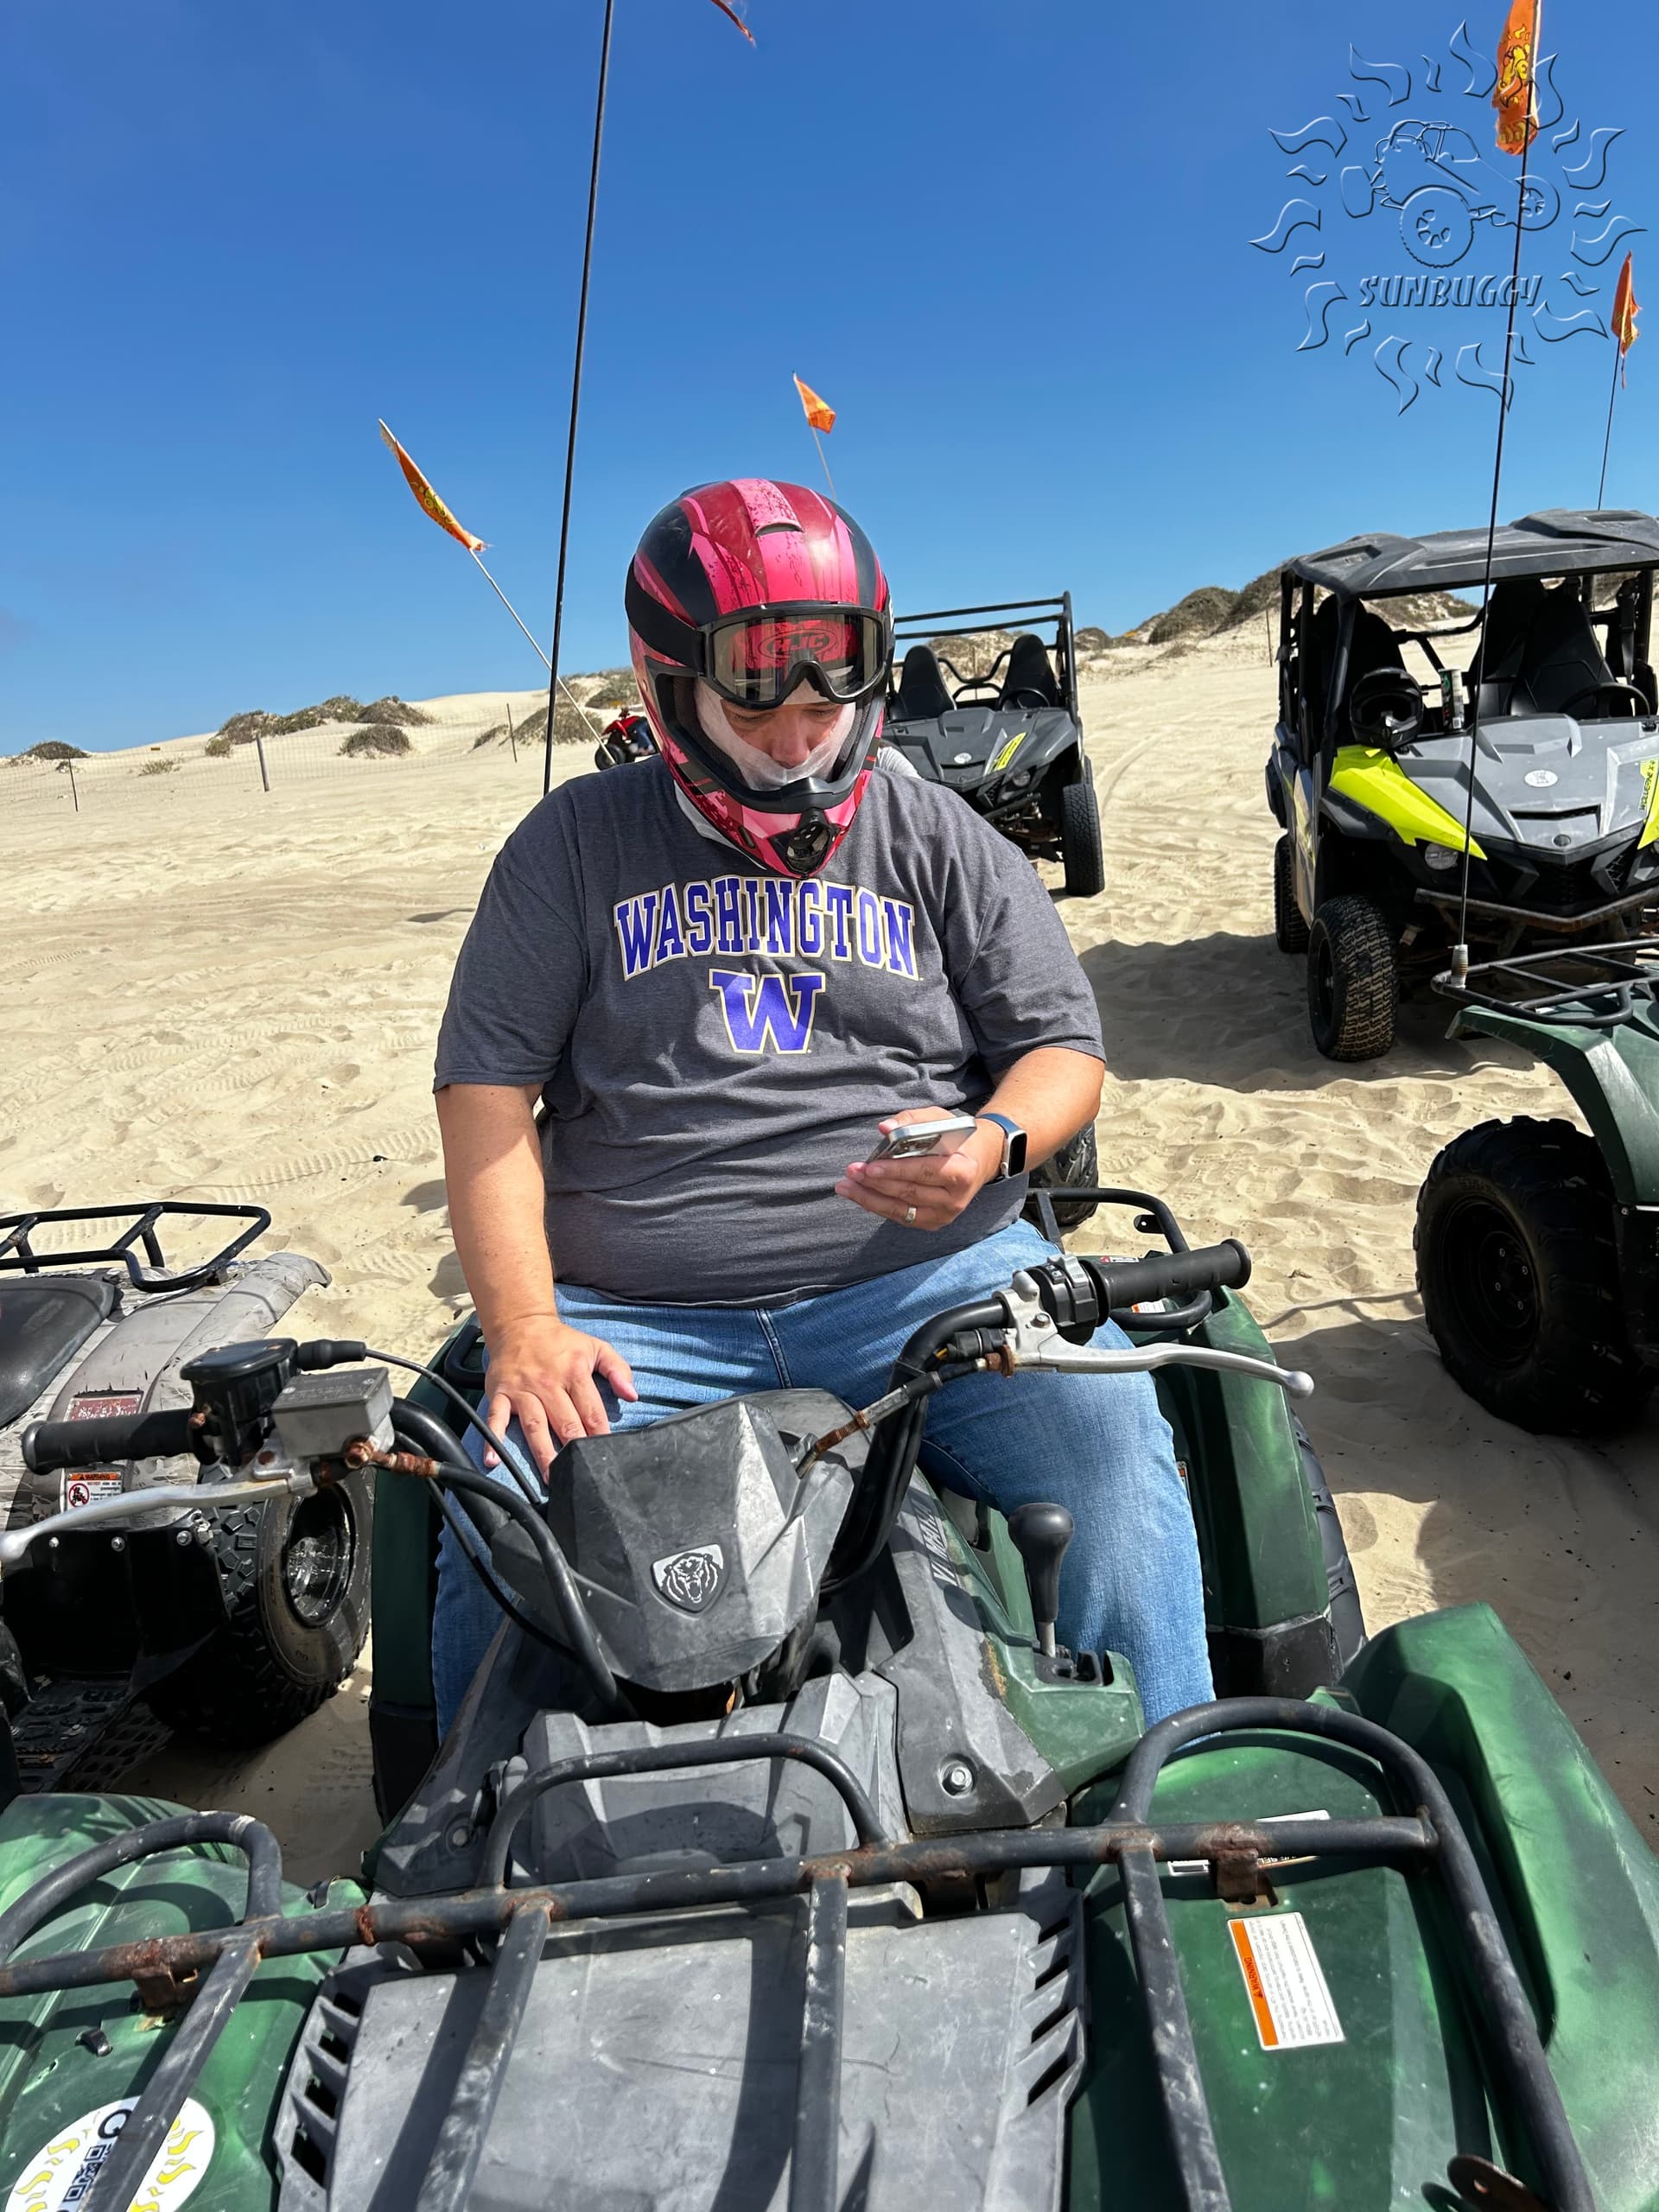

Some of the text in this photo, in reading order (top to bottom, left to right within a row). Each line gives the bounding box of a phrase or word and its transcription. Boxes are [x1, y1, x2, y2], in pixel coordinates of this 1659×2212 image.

[772, 634, 828, 653] HJC
[613, 874, 919, 982] WASHINGTON
[709, 969, 826, 1055] W
[1244, 1957, 1260, 1991] WARNING
